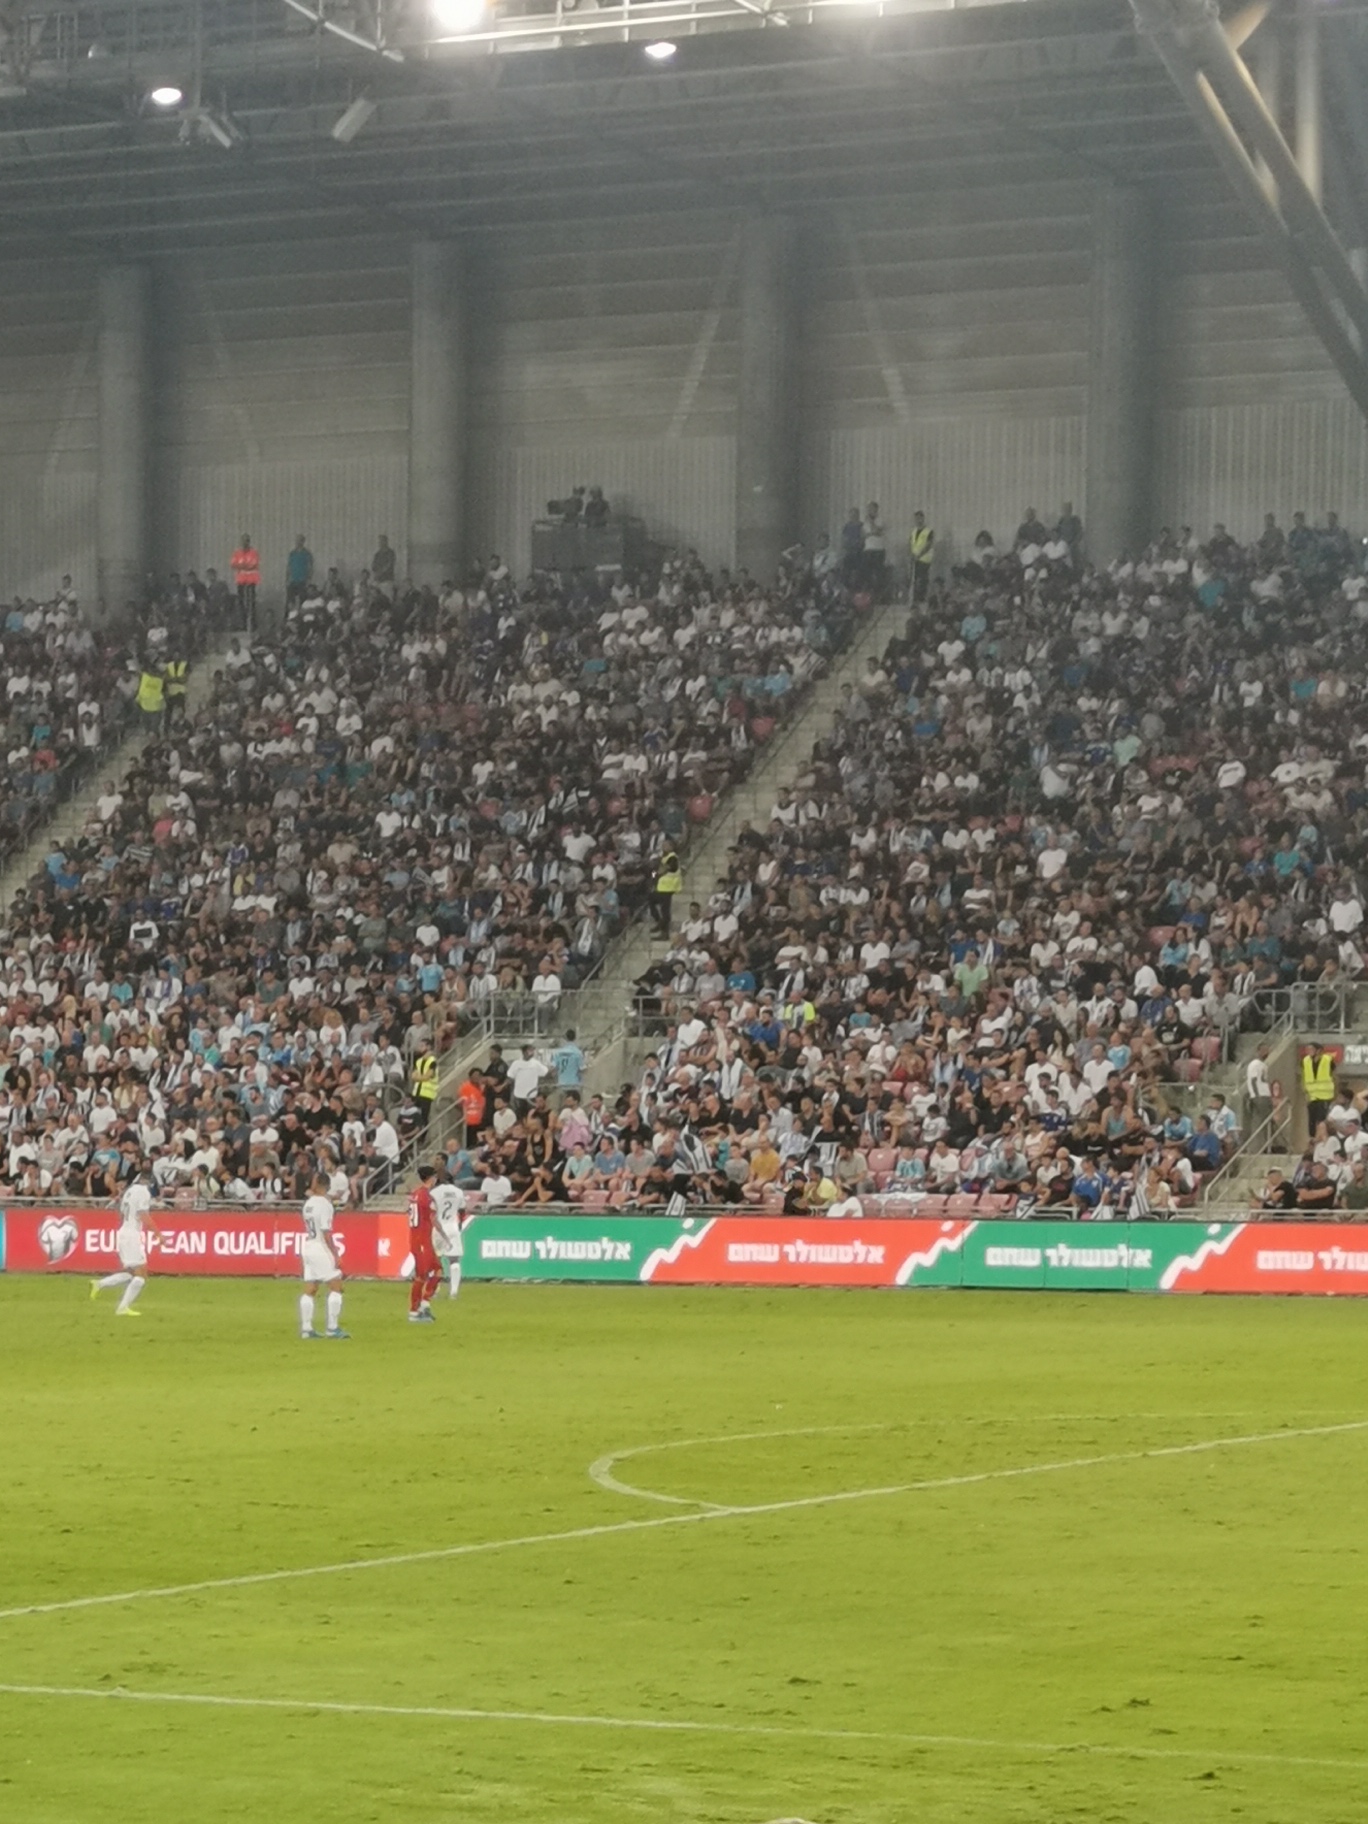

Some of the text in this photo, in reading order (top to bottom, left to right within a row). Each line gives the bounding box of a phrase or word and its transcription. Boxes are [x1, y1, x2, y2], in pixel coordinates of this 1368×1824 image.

[441, 1201, 453, 1220] 2
[85, 1228, 207, 1254] EUPEAN
[213, 1231, 346, 1257] QUALIFIS
[481, 1236, 631, 1261] אלטשולר שחם
[728, 1239, 885, 1264] אלטשולר שחם
[985, 1243, 1153, 1268] אלטשולר שחם
